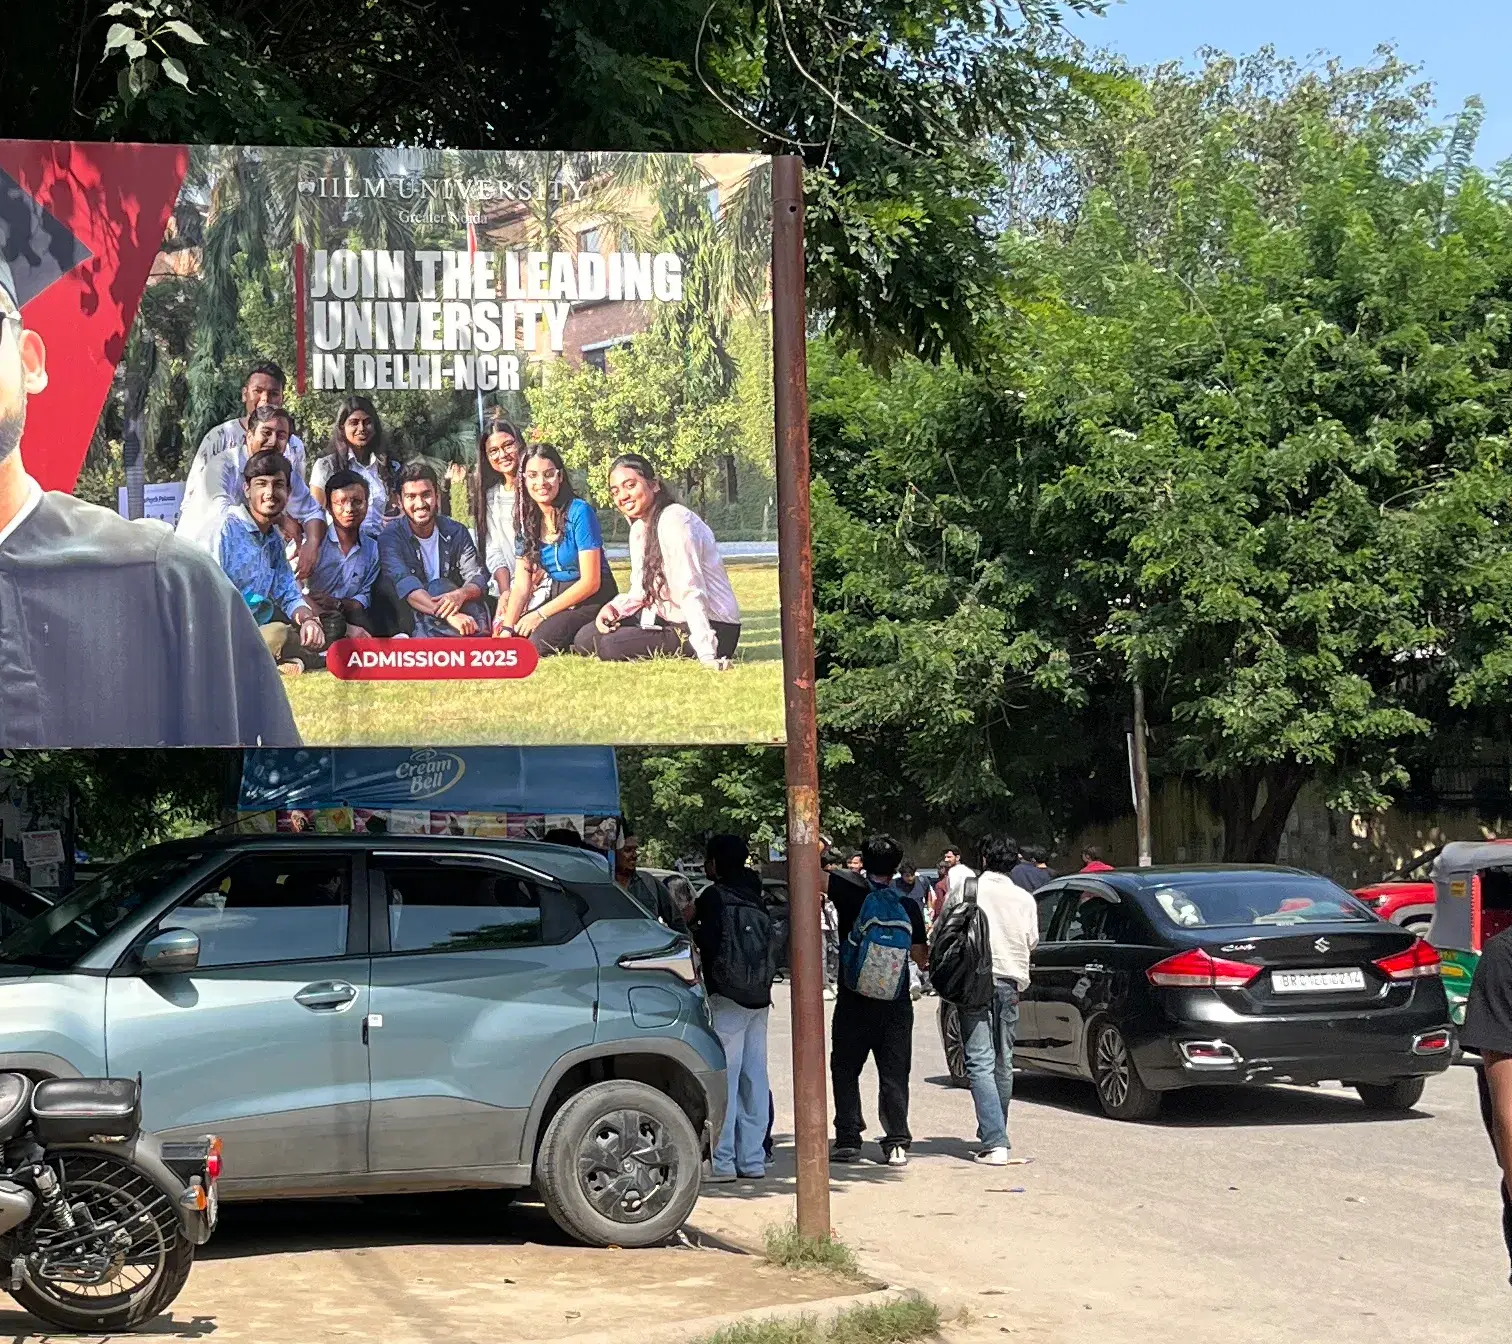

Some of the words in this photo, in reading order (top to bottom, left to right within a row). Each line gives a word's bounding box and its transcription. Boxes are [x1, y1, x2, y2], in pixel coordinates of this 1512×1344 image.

[319, 177, 387, 198] IILM
[396, 178, 586, 201] UNIVERSITY
[310, 249, 406, 299] JOIN
[416, 250, 497, 300] THE
[504, 251, 683, 302] LEADING
[312, 300, 570, 352] UNIVERSITY
[312, 353, 347, 391] IN
[354, 354, 521, 392] DELHI-NCR
[347, 650, 465, 668] ADMISSION
[470, 649, 518, 667] 2025
[395, 759, 452, 779] Cream
[410, 771, 443, 795] Bell
